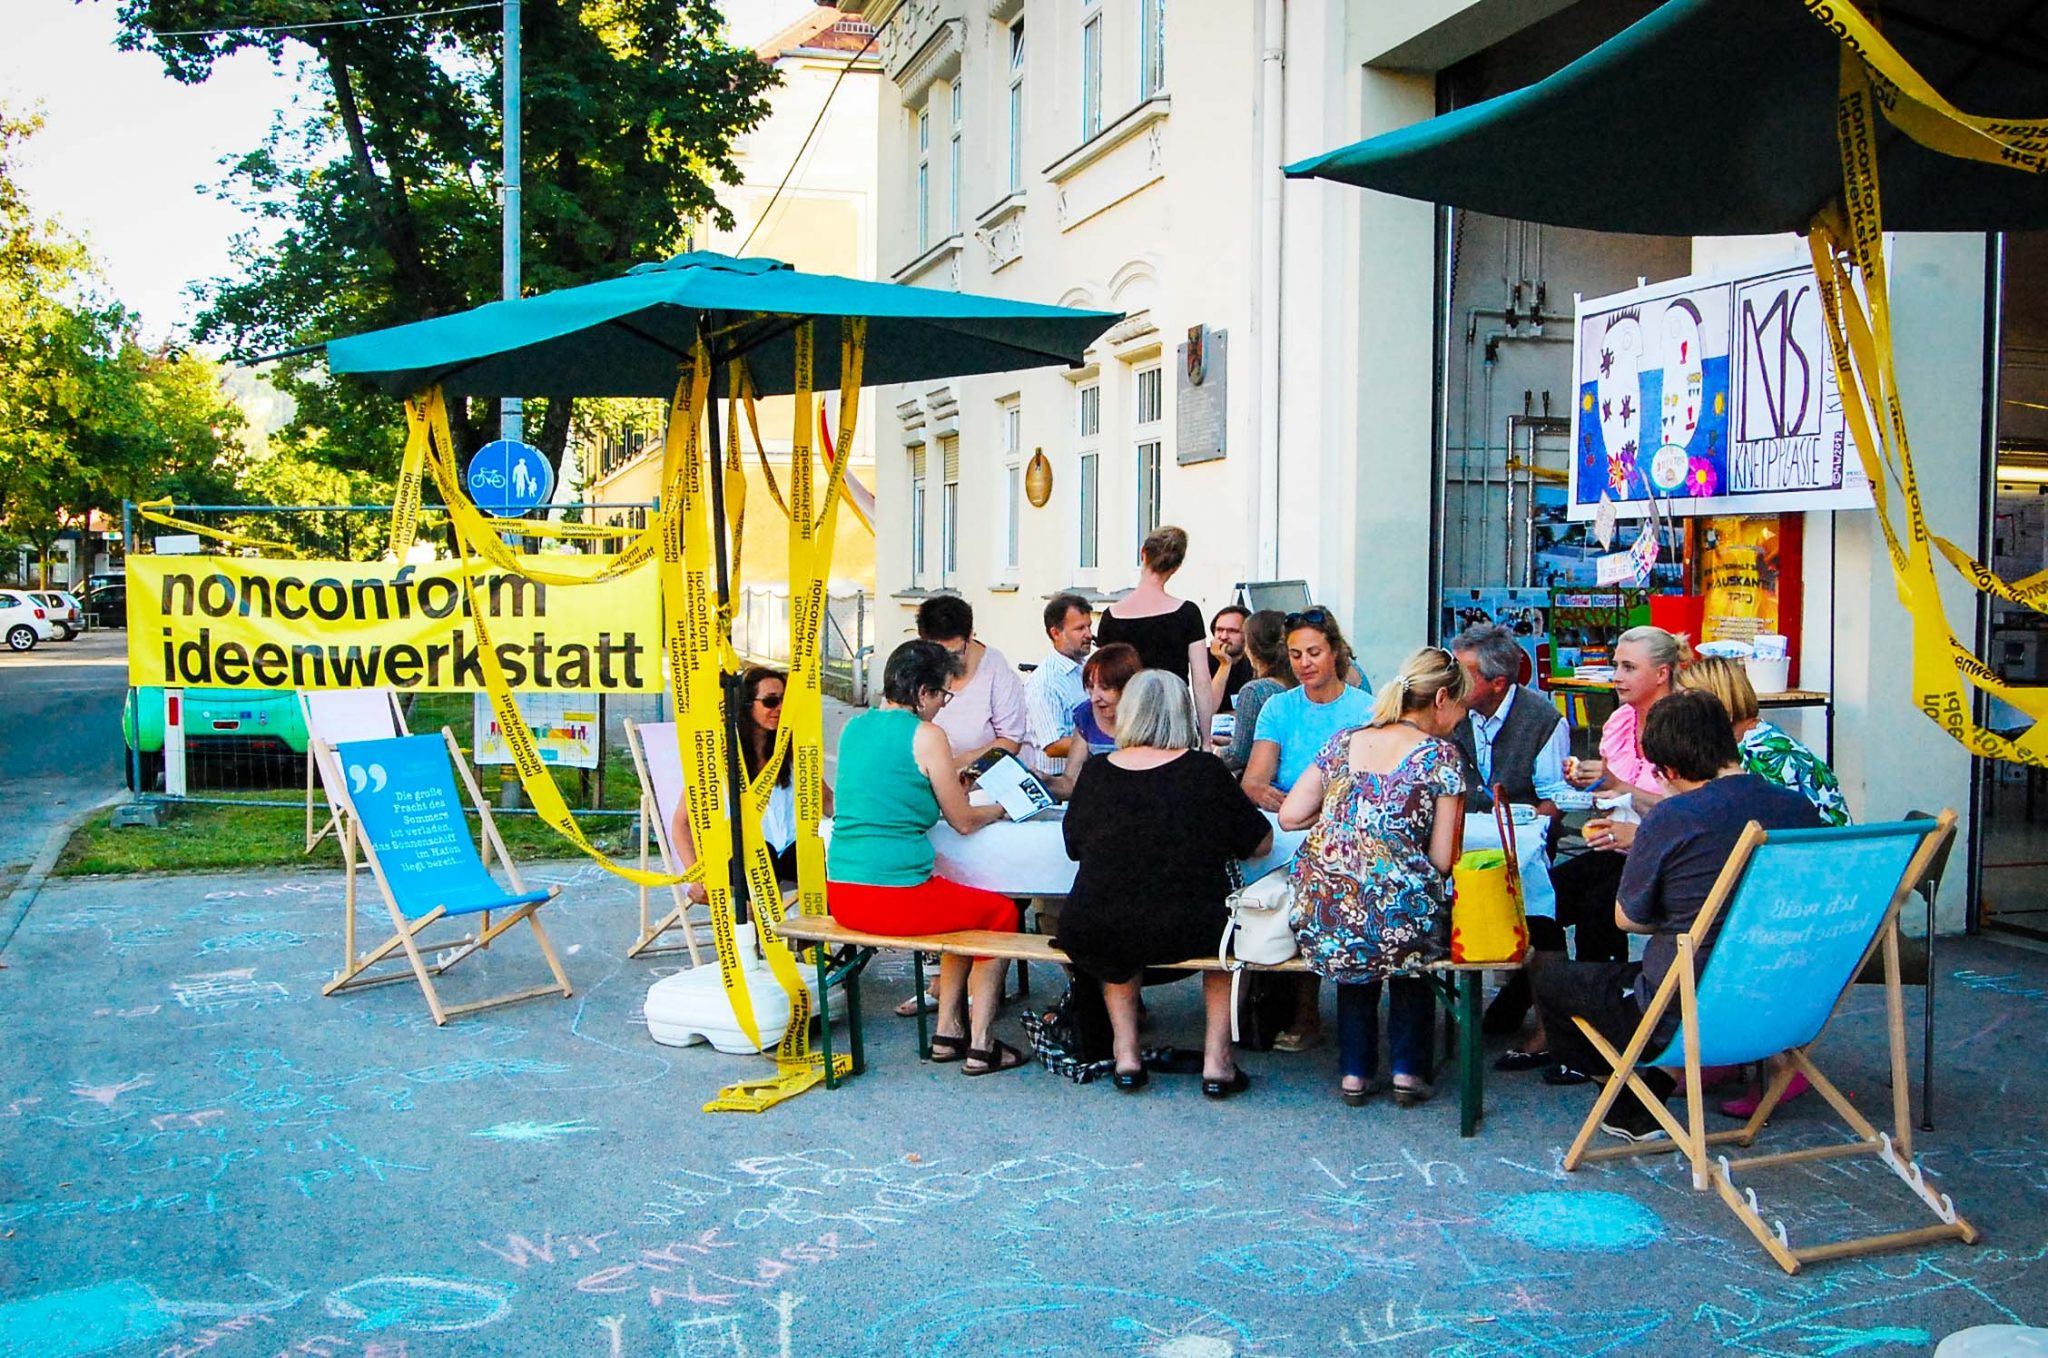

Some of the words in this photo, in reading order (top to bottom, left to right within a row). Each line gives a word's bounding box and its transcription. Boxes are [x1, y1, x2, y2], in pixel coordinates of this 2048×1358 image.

[161, 566, 546, 621] nonconform
[686, 571, 700, 671] ideenwerkstatt
[696, 571, 709, 652] nonconform
[806, 579, 823, 657] nonconform
[163, 627, 644, 688] ideenwerkstatt
[671, 637, 685, 713] nonconform
[499, 711, 533, 778] nonconform
[501, 694, 543, 774] ideenwerkstatt
[705, 730, 719, 811] nonconform
[395, 791, 413, 801] Die
[694, 730, 712, 830] ideenwerkstatt
[711, 889, 734, 988] ideenwerkstatt
[719, 888, 736, 969] nonconform
[752, 869, 774, 944] nonconform
